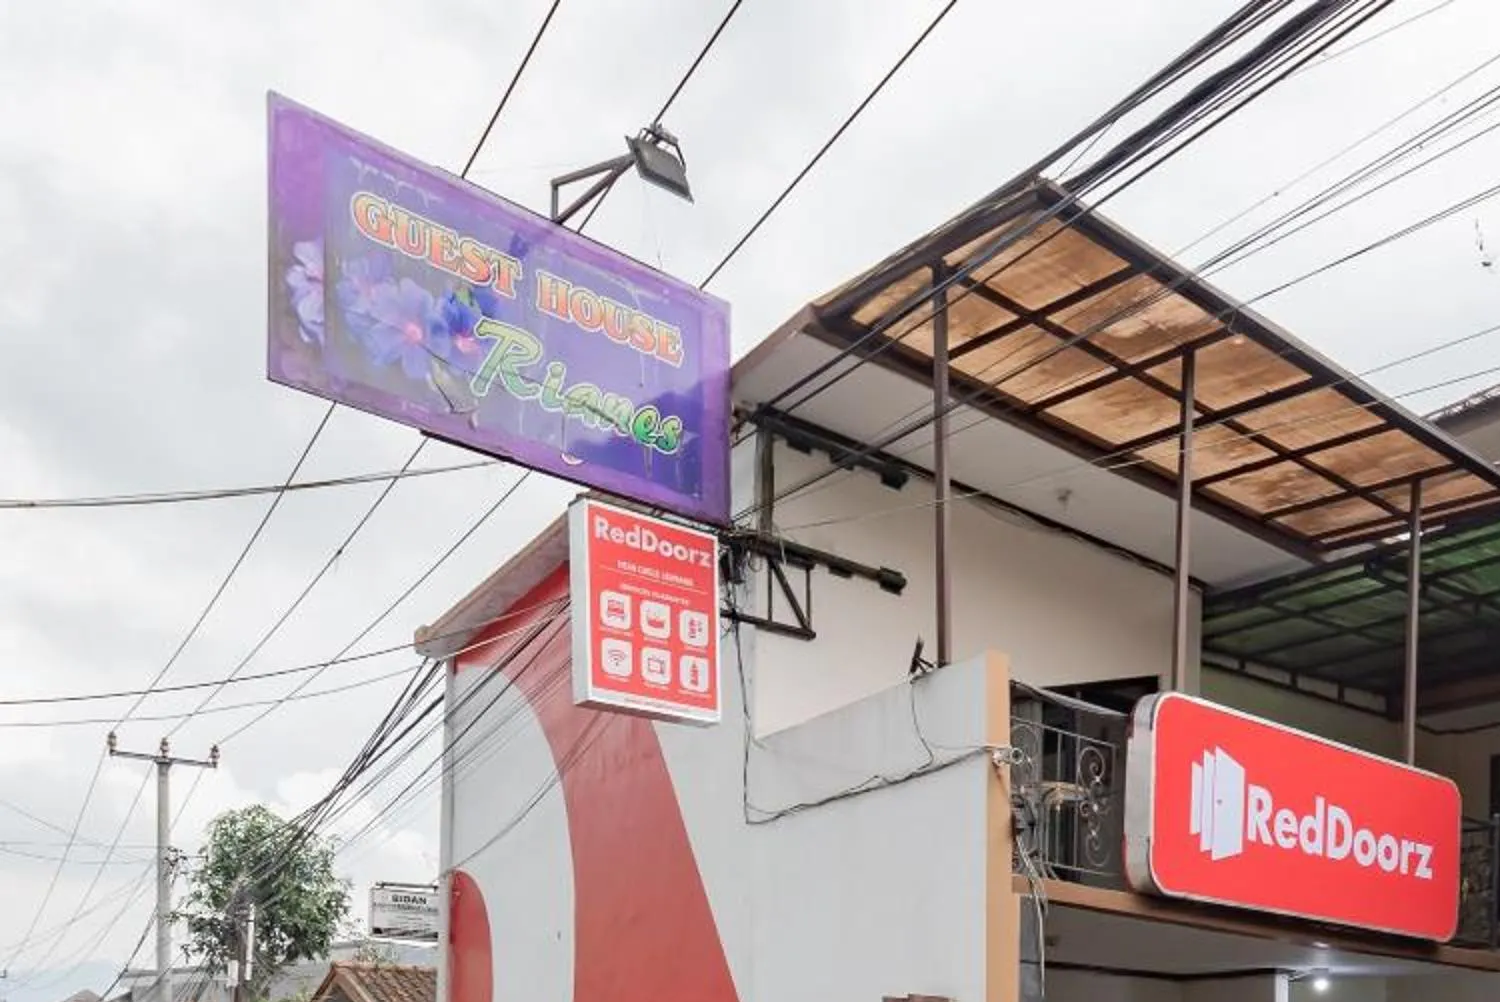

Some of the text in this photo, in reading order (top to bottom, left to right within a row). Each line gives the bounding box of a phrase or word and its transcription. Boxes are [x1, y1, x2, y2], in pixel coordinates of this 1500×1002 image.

[351, 192, 684, 368] GUEST HOUSE
[594, 516, 712, 568] RedDoorz
[1248, 784, 1433, 879] RedDoorz
